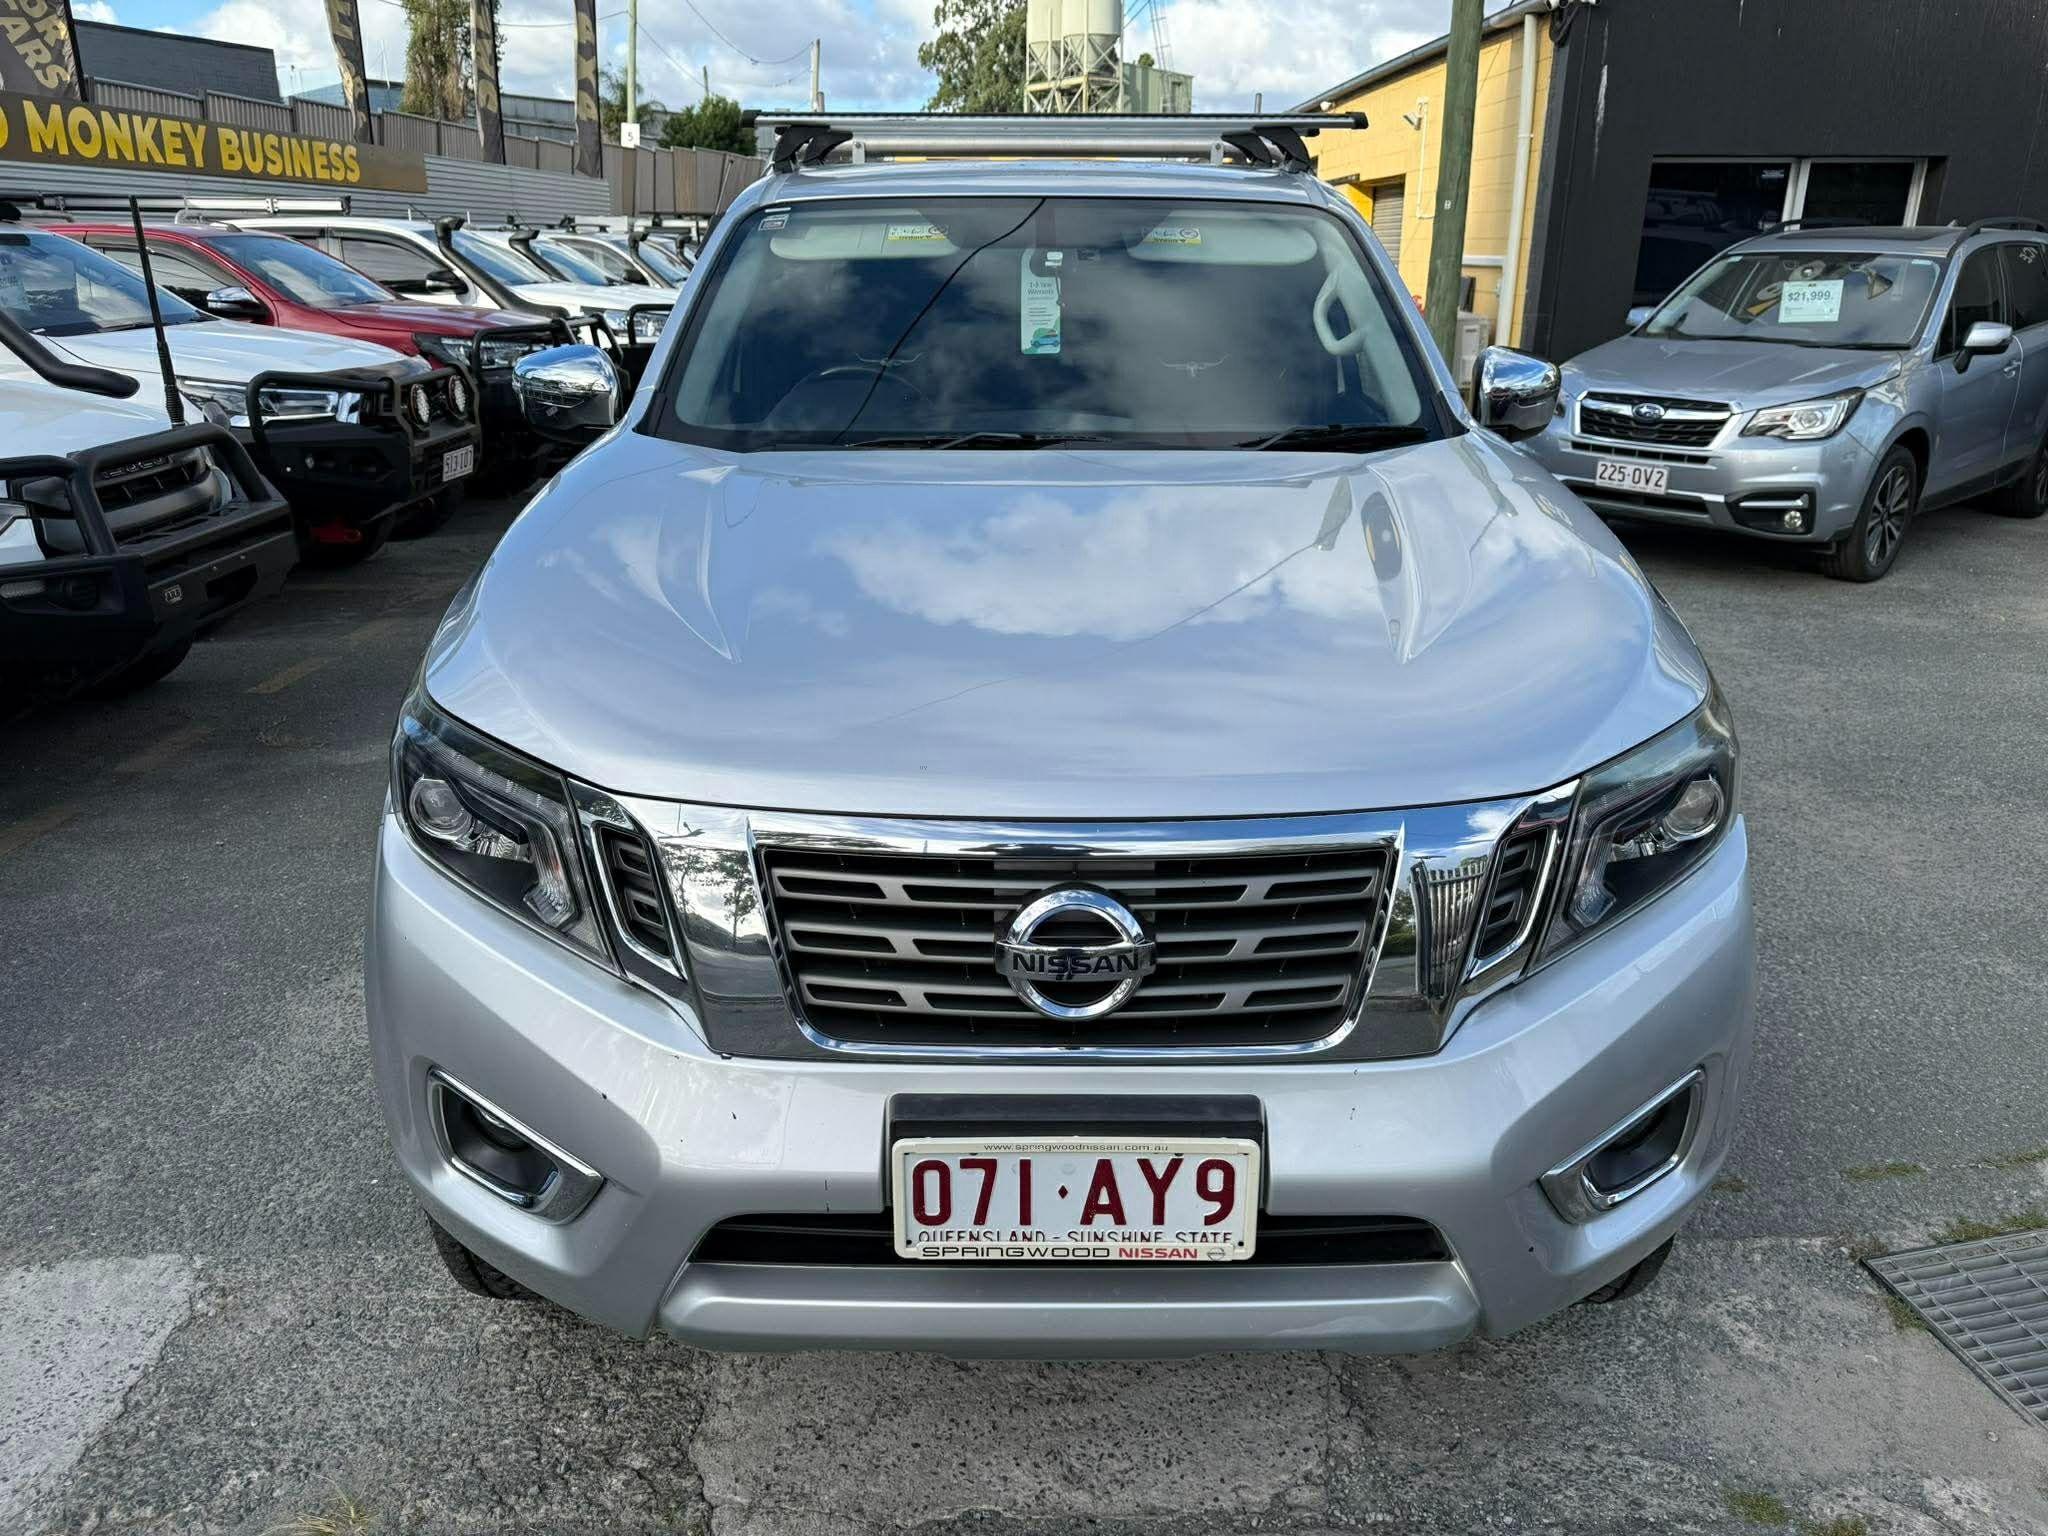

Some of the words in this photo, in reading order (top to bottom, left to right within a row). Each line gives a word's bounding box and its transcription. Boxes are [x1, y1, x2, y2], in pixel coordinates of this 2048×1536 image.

[0, 2, 71, 89] ARS
[22, 99, 207, 168] MONKEY
[217, 127, 361, 183] BUSINESS
[1012, 952, 1140, 974] NISSAN
[983, 1143, 1169, 1152] www.springwoodnissan.com.au
[1067, 1230, 1164, 1242] SUNSHINE
[1175, 1231, 1233, 1243] STATE
[922, 1246, 1110, 1258] SPRINGWOOD
[1118, 1247, 1198, 1259] NISSAN
